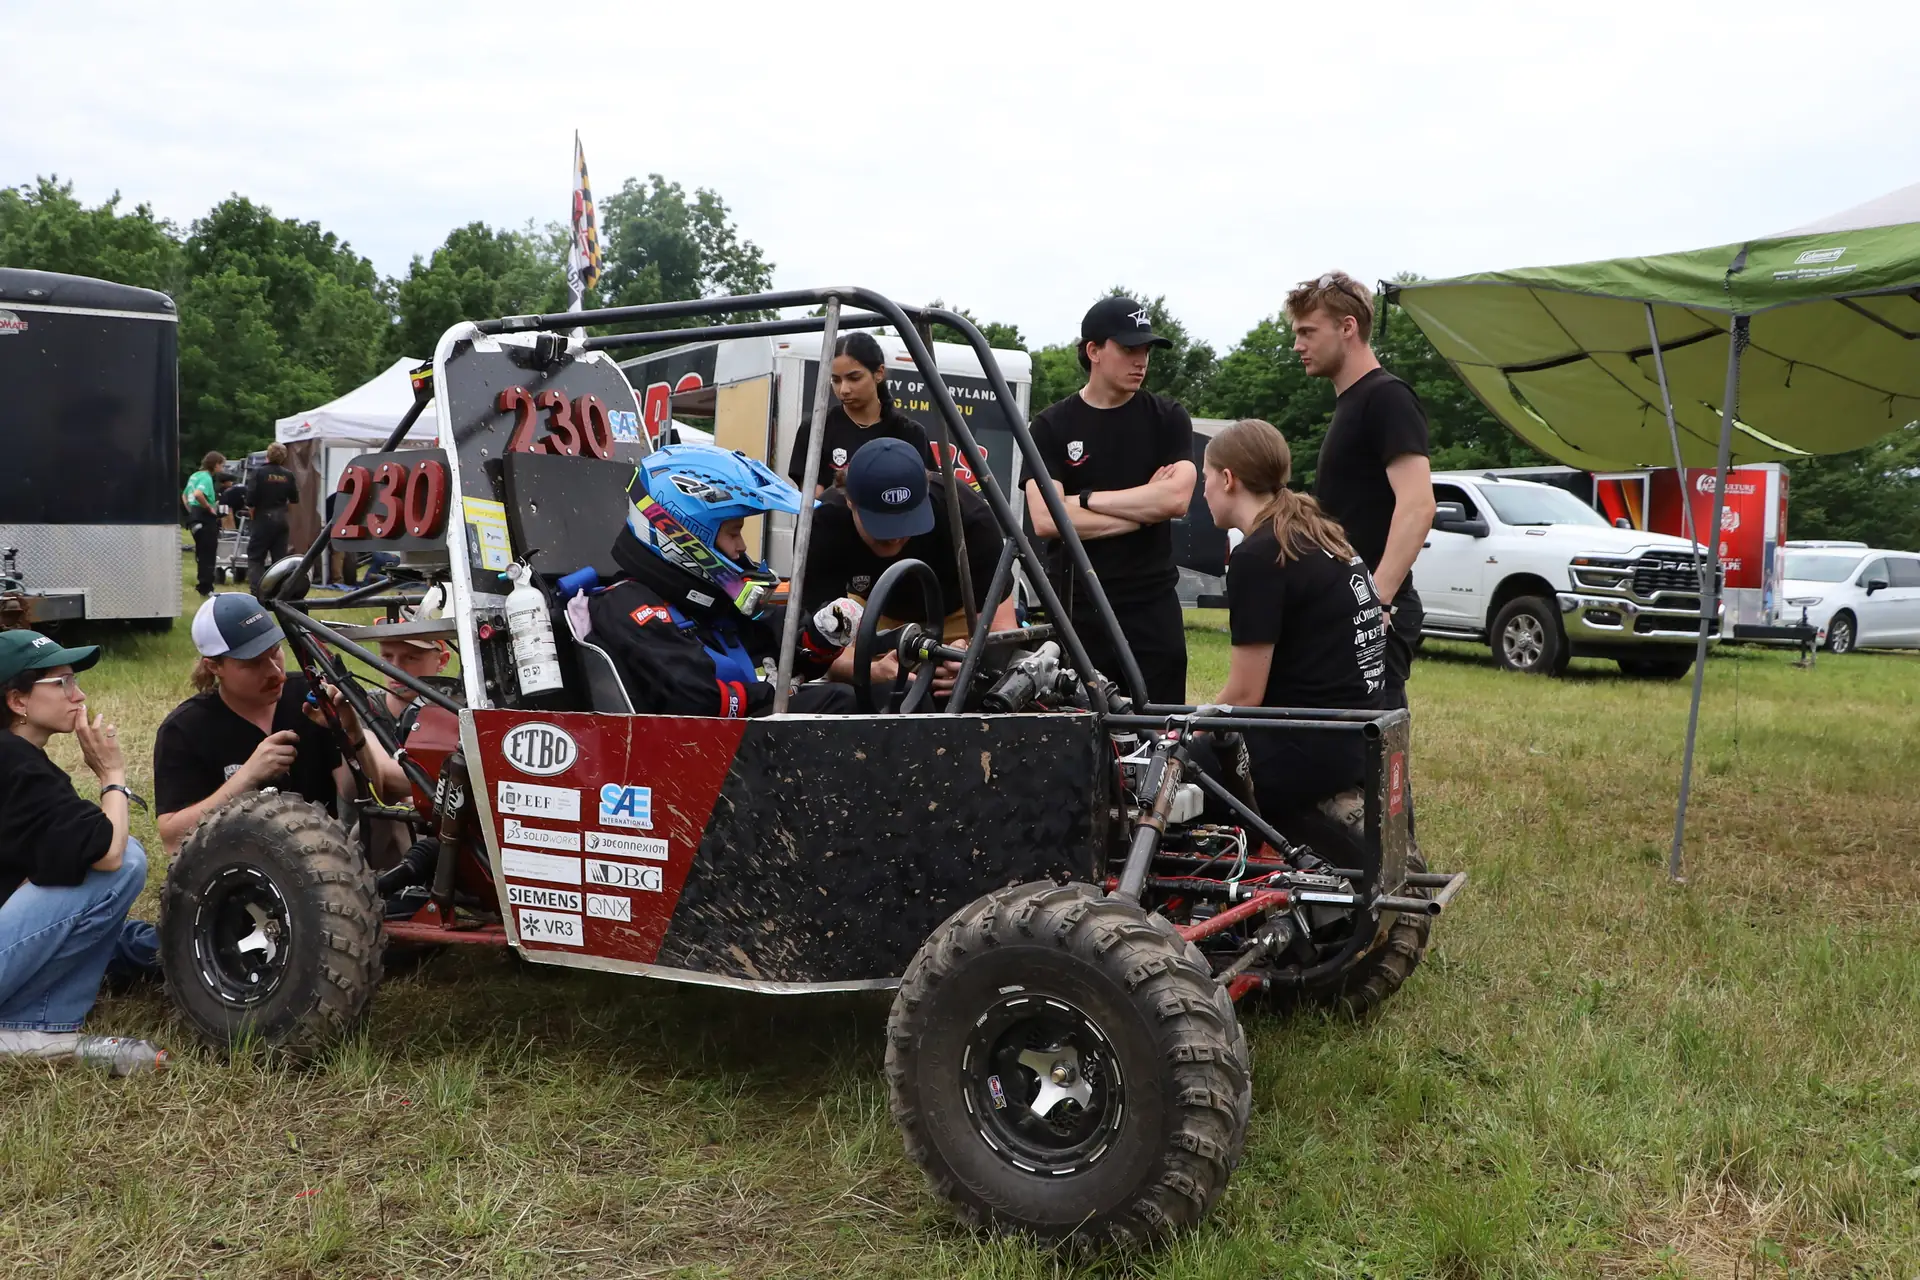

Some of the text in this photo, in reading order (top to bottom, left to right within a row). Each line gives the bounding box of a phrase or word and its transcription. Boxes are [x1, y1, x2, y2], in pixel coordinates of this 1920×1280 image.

[907, 382, 924, 393] OF
[949, 386, 997, 401] RYLAND
[500, 386, 615, 460] 230
[331, 459, 445, 540] 230
[884, 489, 908, 503] ETBO
[510, 729, 568, 769] ETBO
[525, 794, 552, 809] EEF
[601, 784, 649, 819] SAE
[601, 817, 650, 828] INTERNATIONAL
[523, 831, 578, 846] SOLIDWORKS
[606, 864, 661, 890] DBG
[509, 887, 578, 909] SIEMENS
[587, 896, 630, 918] QNX
[544, 918, 573, 937] VR3
